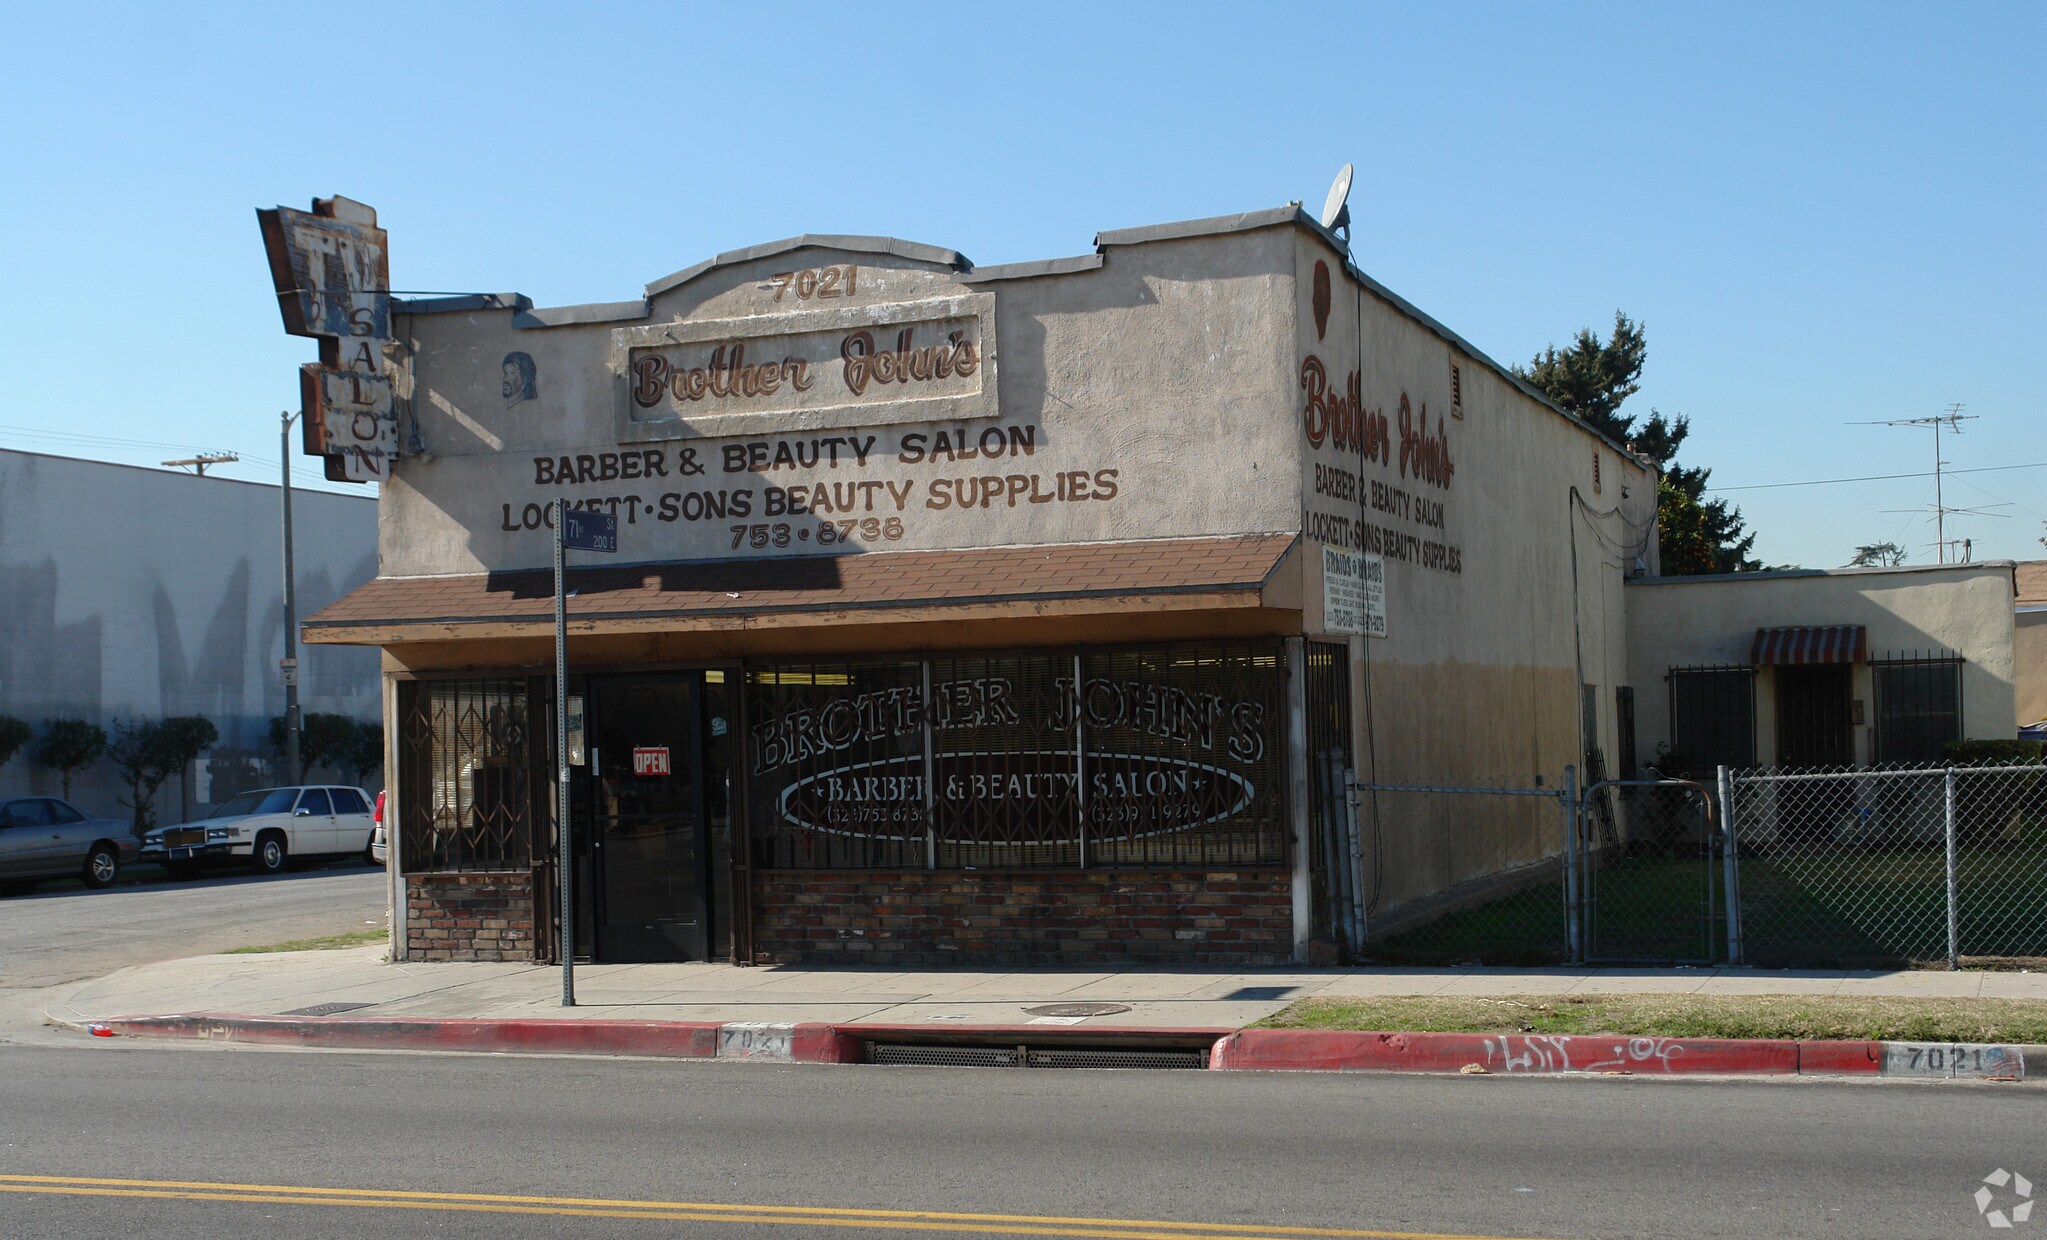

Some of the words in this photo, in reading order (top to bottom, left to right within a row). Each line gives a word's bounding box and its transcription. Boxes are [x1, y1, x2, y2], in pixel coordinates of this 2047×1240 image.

[771, 265, 858, 302] 7021
[634, 343, 813, 408] Brother
[842, 328, 980, 396] John's
[350, 307, 380, 476] SALON
[1301, 355, 1390, 468] Brother
[1398, 391, 1454, 490] John's
[533, 449, 669, 485] BARBER
[678, 448, 706, 476] &
[722, 435, 877, 475] BEAUTY
[899, 425, 1036, 465] SALON
[765, 479, 914, 518] BEAUTY
[926, 469, 1120, 511] SUPPLIES
[1315, 462, 1357, 503] BARBER
[1358, 476, 1367, 509] &
[1371, 480, 1411, 521] BEAUTY
[1415, 496, 1445, 530] SALON
[593, 535, 608, 549] 200
[610, 536, 615, 549] E
[606, 518, 614, 531] St
[1325, 550, 1352, 577] BRAIDS
[1383, 528, 1421, 565] BEAUTY
[1423, 540, 1462, 574] SUPPLIES
[753, 677, 1020, 777] BROTHER
[1047, 677, 1265, 765] JOHN'S
[634, 752, 668, 773] OPEN
[945, 774, 966, 801] &
[970, 772, 1079, 800] BEAUTY
[1092, 769, 1188, 799] SALON
[1907, 1047, 1983, 1071] 7021
